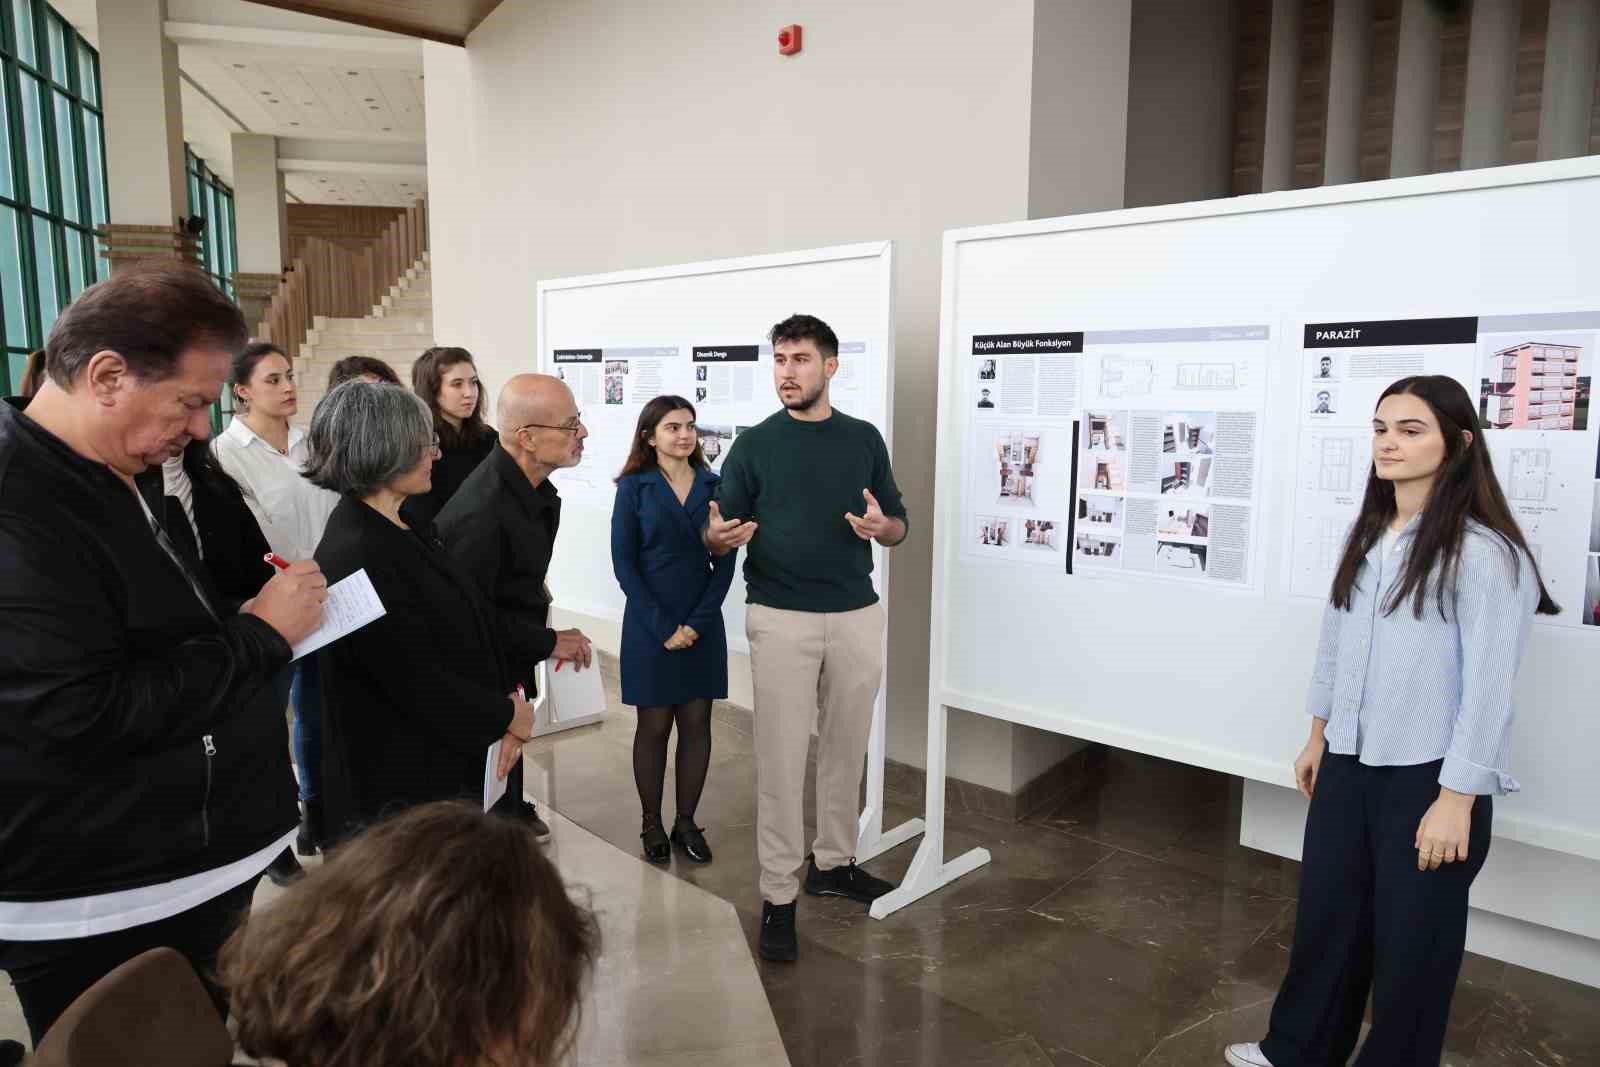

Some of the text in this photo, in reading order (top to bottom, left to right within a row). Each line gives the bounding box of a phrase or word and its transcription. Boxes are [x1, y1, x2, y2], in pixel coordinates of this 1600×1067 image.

[1315, 328, 1361, 340] PARAZİT
[974, 338, 1072, 351] Küçük Alan Büyük Fonksiyon
